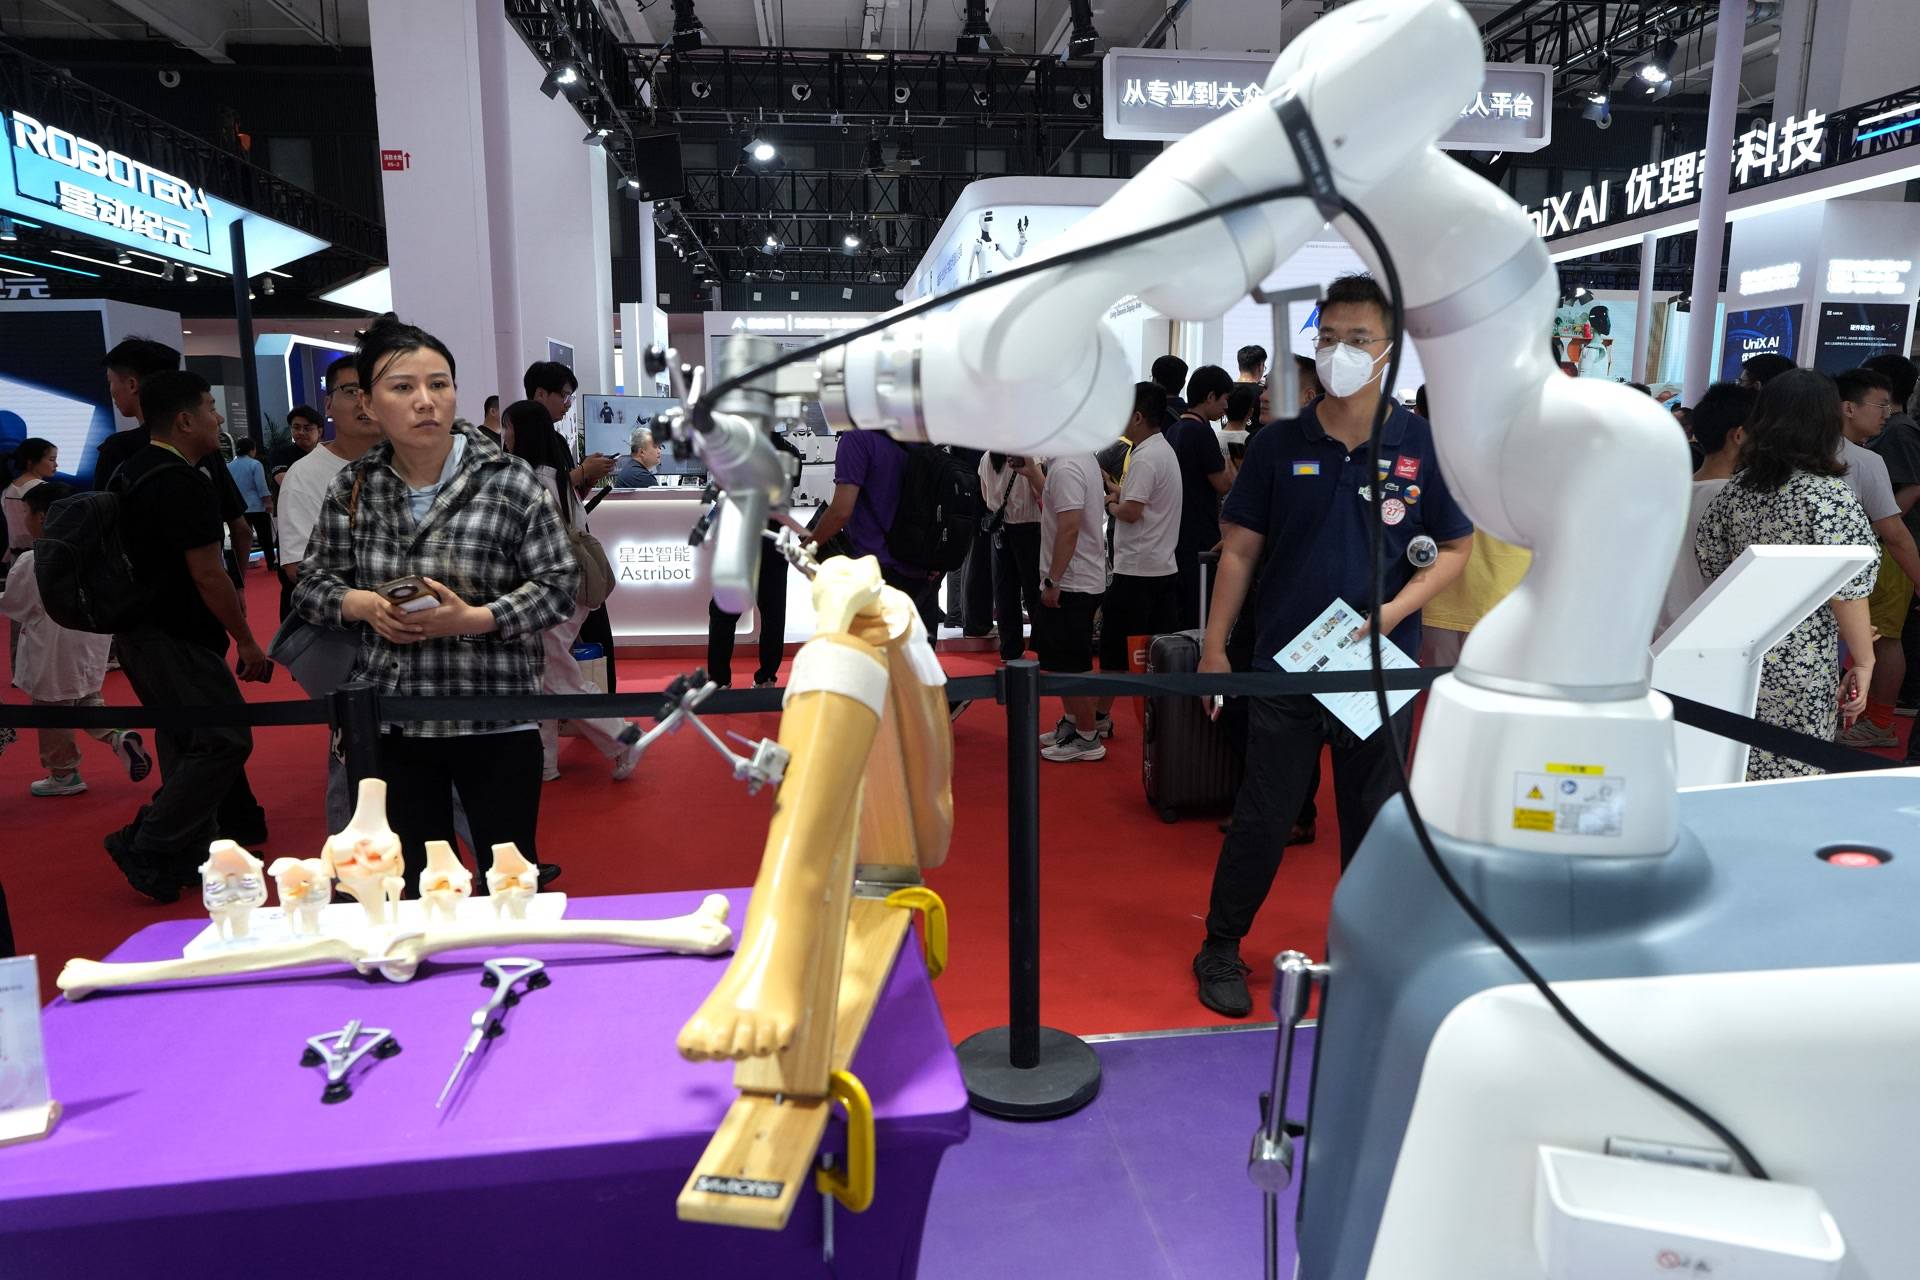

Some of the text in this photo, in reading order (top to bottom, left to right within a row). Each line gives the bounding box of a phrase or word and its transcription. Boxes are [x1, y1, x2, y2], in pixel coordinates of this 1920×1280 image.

[1460, 91, 1534, 117] 人平台
[12, 110, 213, 218] ROBOTERA
[59, 181, 194, 251] 星动纪元
[1521, 190, 1573, 238] niX
[1386, 507, 1398, 516] 27
[619, 545, 691, 563] 星尘智能
[620, 565, 692, 581] Astribot
